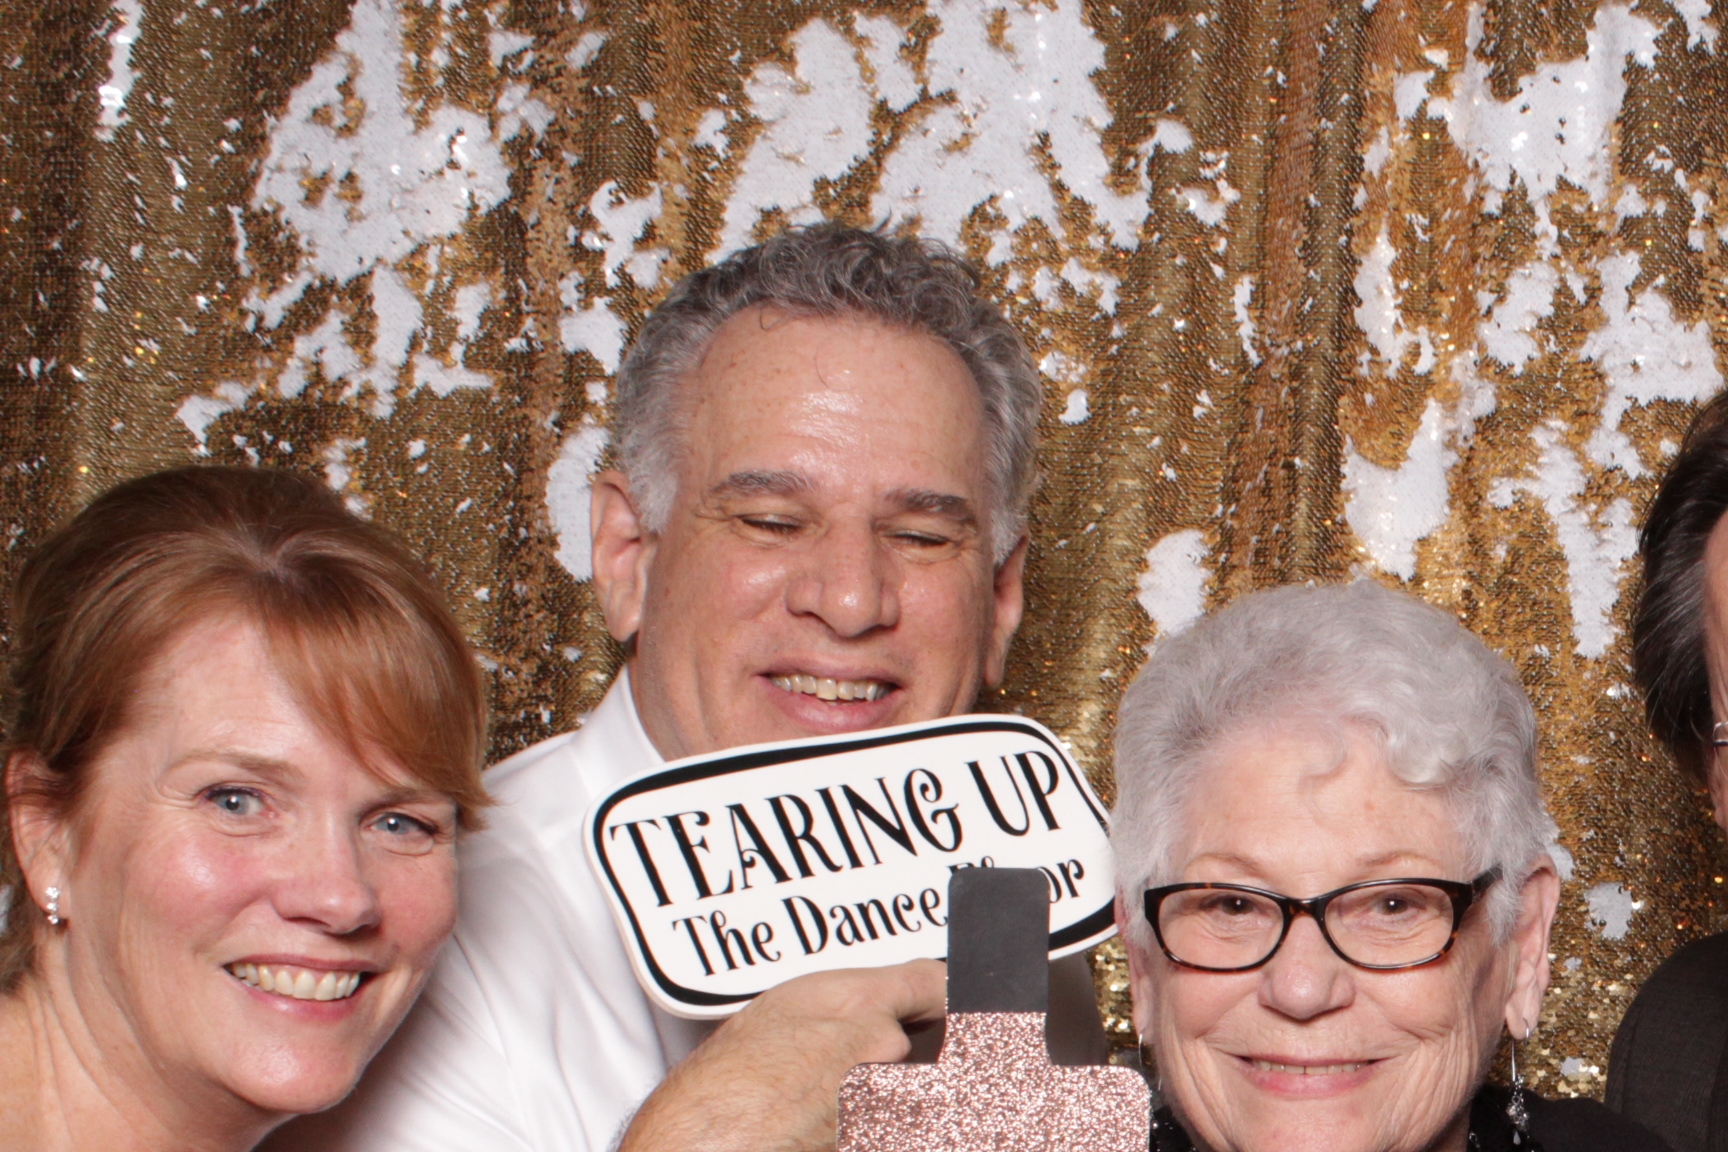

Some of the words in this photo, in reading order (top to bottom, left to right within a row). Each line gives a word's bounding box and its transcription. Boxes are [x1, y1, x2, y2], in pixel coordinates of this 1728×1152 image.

[610, 768, 964, 907] TEARING
[963, 750, 1061, 837] UP
[672, 910, 782, 977] The
[781, 884, 949, 956] Dance
